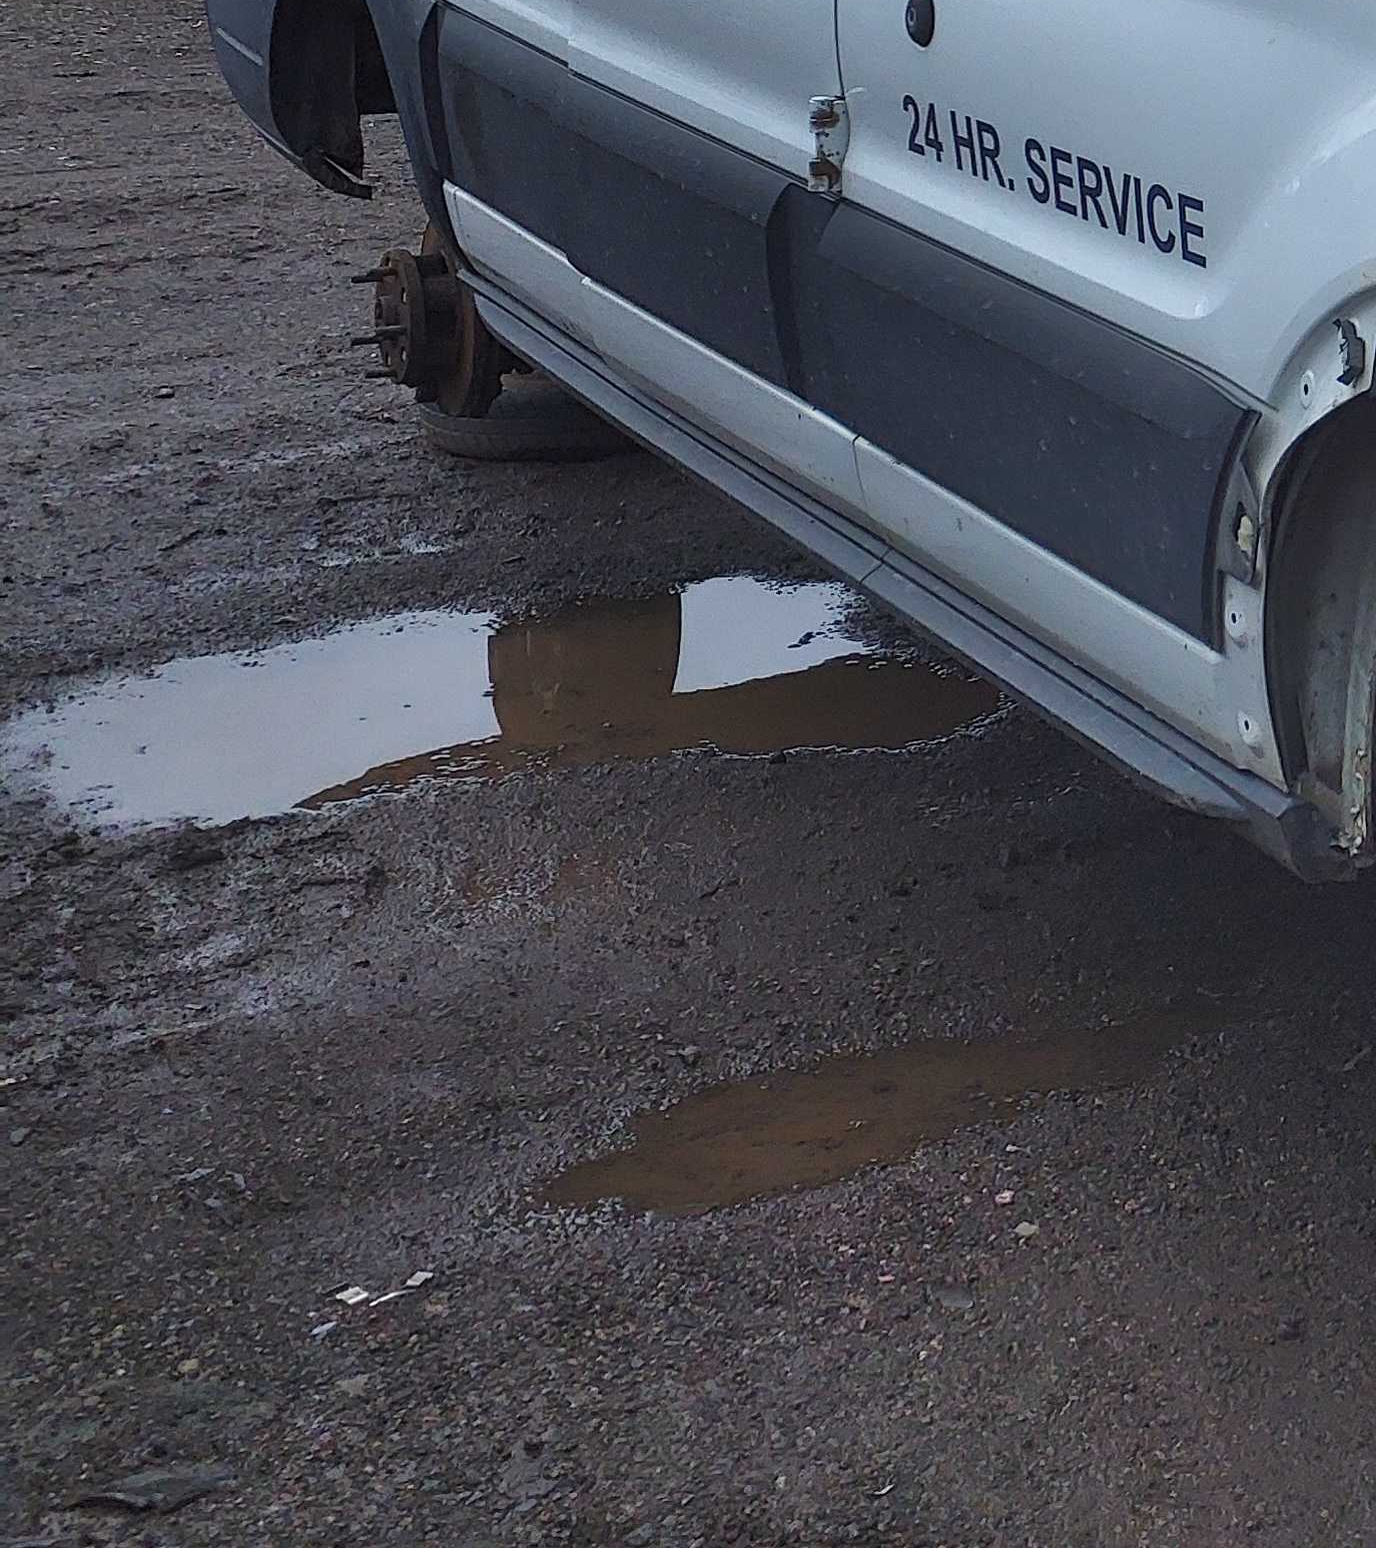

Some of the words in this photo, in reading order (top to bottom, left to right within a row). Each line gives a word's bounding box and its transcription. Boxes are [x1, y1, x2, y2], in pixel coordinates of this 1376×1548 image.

[902, 93, 944, 163] 24
[950, 109, 1016, 191] HR.
[1025, 137, 1207, 268] SERVICE
